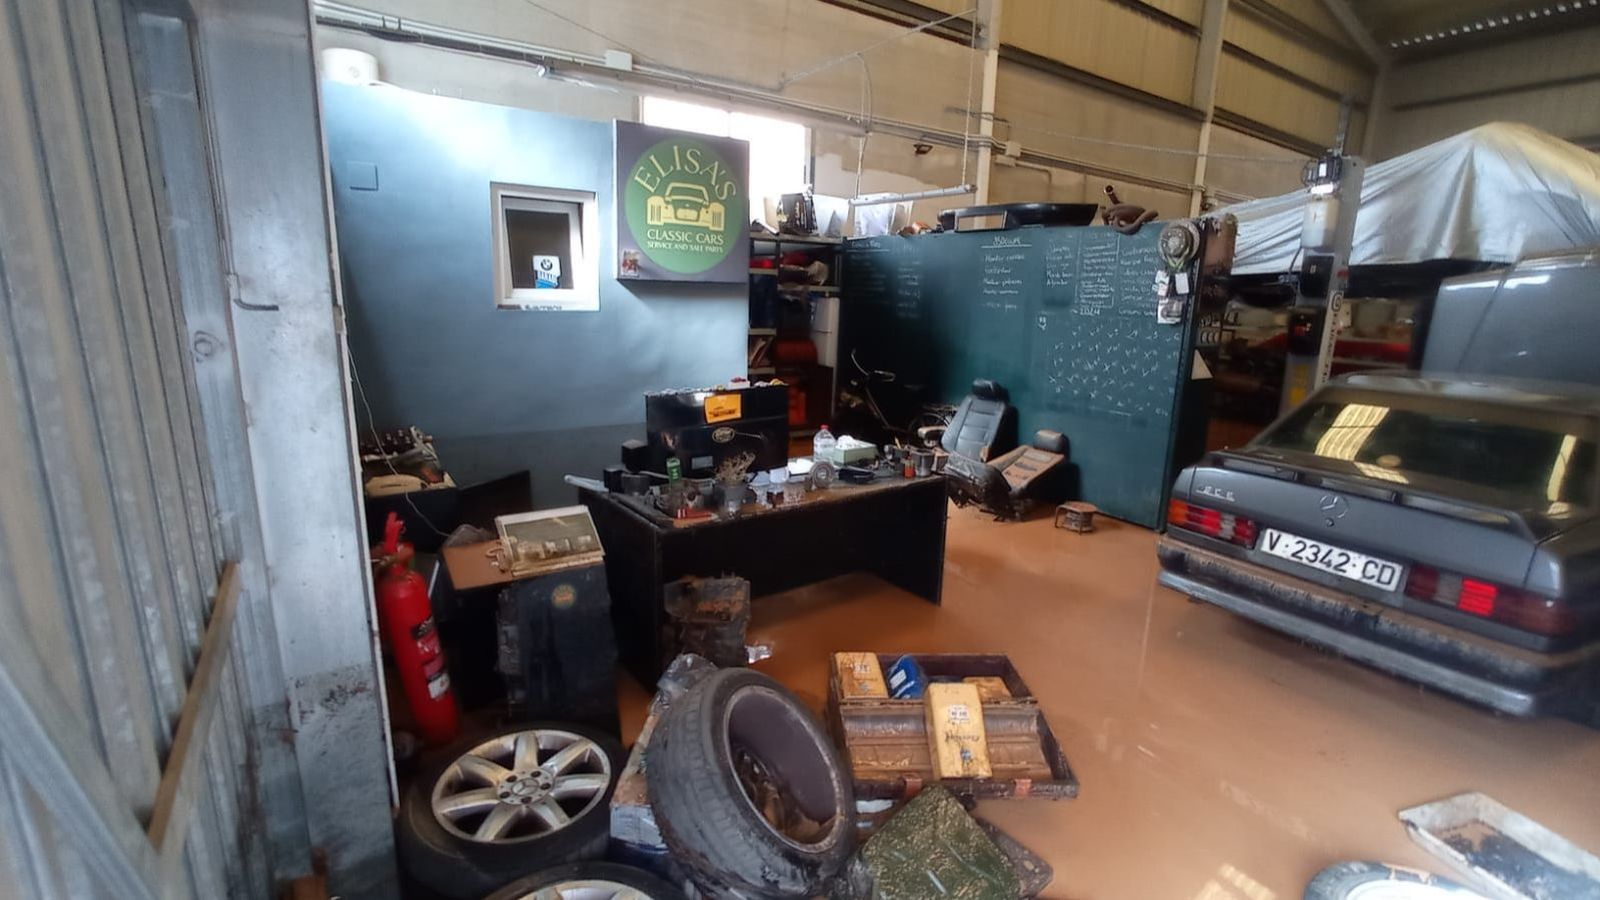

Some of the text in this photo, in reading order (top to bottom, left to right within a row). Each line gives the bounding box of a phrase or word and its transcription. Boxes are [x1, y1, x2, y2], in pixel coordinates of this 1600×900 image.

[634, 145, 737, 201] ELISA'S
[647, 229, 724, 246] CLASSIC CARS
[647, 241, 723, 254] SERVICE AND SALE PARTS
